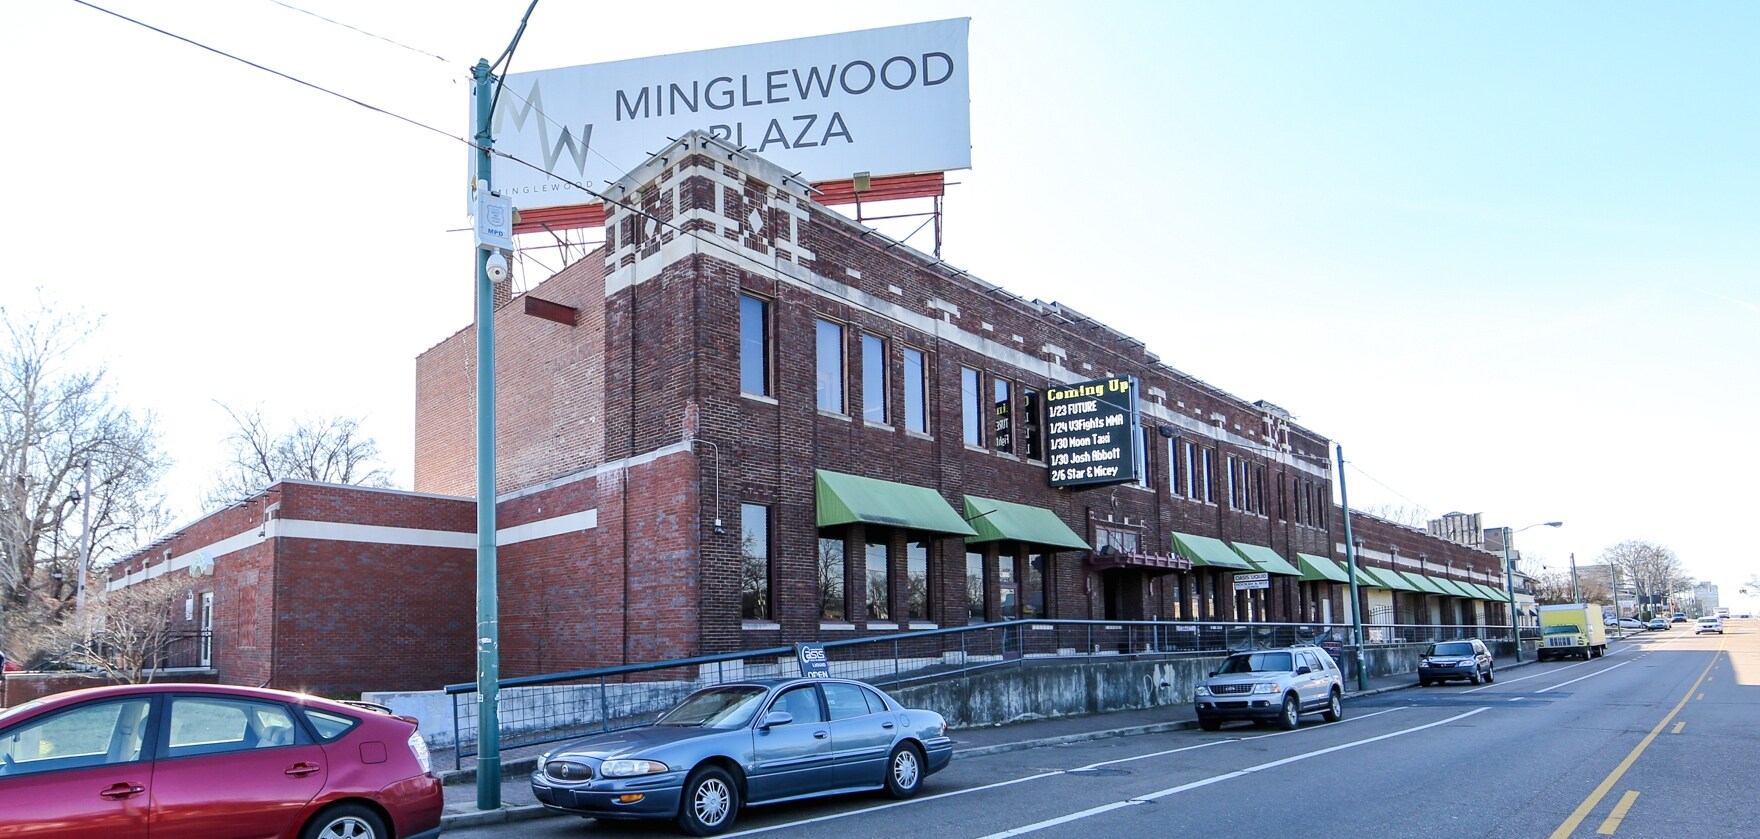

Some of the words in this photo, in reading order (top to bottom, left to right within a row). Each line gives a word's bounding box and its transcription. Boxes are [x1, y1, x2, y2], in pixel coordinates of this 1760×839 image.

[616, 51, 954, 121] MINGLEWOOD
[709, 111, 854, 153] PLAZA
[487, 228, 504, 237] MPD
[1047, 385, 1104, 401] Coming
[1108, 379, 1129, 393] Up
[1049, 404, 1067, 418] 1/23
[1068, 400, 1097, 415] FUTURE
[1050, 421, 1068, 434] 1/24
[1068, 416, 1105, 432] V3Fights
[1105, 413, 1124, 427] MMA
[1051, 437, 1069, 450] 1/30
[1069, 436, 1091, 448] Moon
[1092, 432, 1111, 445] Taxi
[1051, 453, 1069, 466] 1/30
[1070, 451, 1091, 464] Josh
[1091, 447, 1121, 461] Abbott
[1051, 468, 1066, 481] 2/6
[1067, 467, 1086, 480] Star
[1093, 464, 1119, 477] Micey
